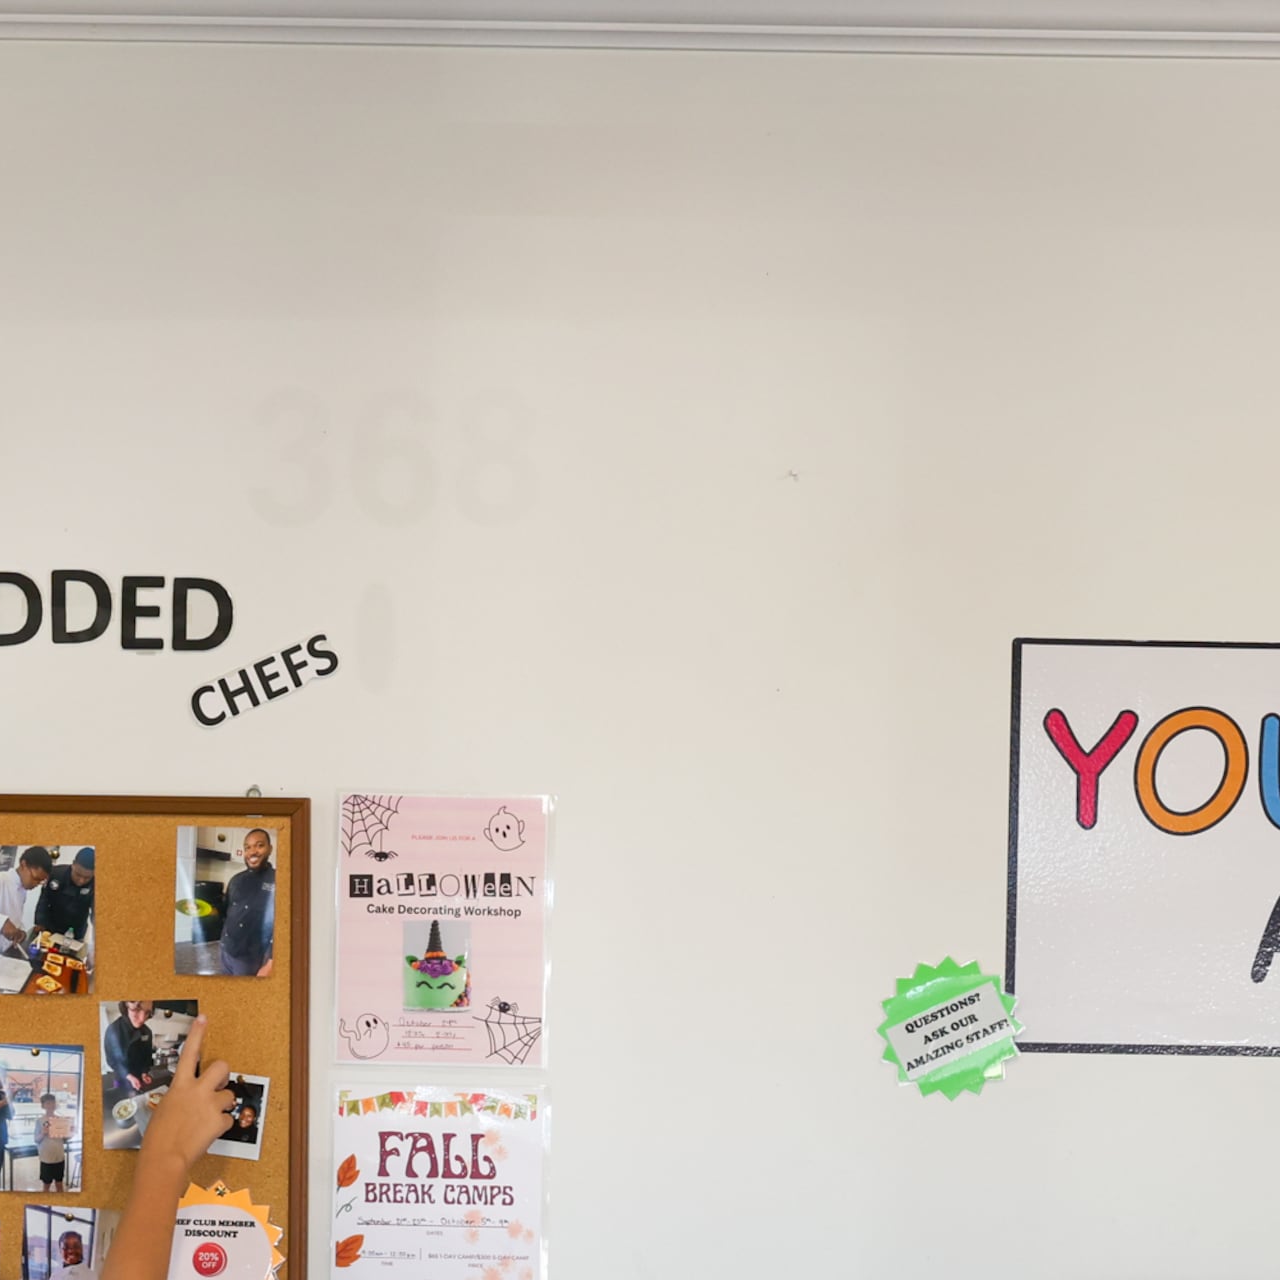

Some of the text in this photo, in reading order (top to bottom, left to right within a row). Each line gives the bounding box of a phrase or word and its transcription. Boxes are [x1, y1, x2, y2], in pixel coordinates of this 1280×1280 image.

[189, 634, 340, 729] CHEFS
[366, 903, 522, 919] Cake Decorating Workshop
[905, 993, 981, 1033] QUESTIONS?
[923, 1013, 979, 1044] ASK OUR
[906, 1018, 1009, 1071] AMAZING STAFF!
[377, 1131, 497, 1180] FALL
[364, 1182, 515, 1206] BREAK CAMPS
[176, 1218, 192, 1226] HEF
[218, 1220, 256, 1228] MEMBER
[184, 1229, 239, 1238] DISCOUNT
[198, 1252, 220, 1261] 20%
